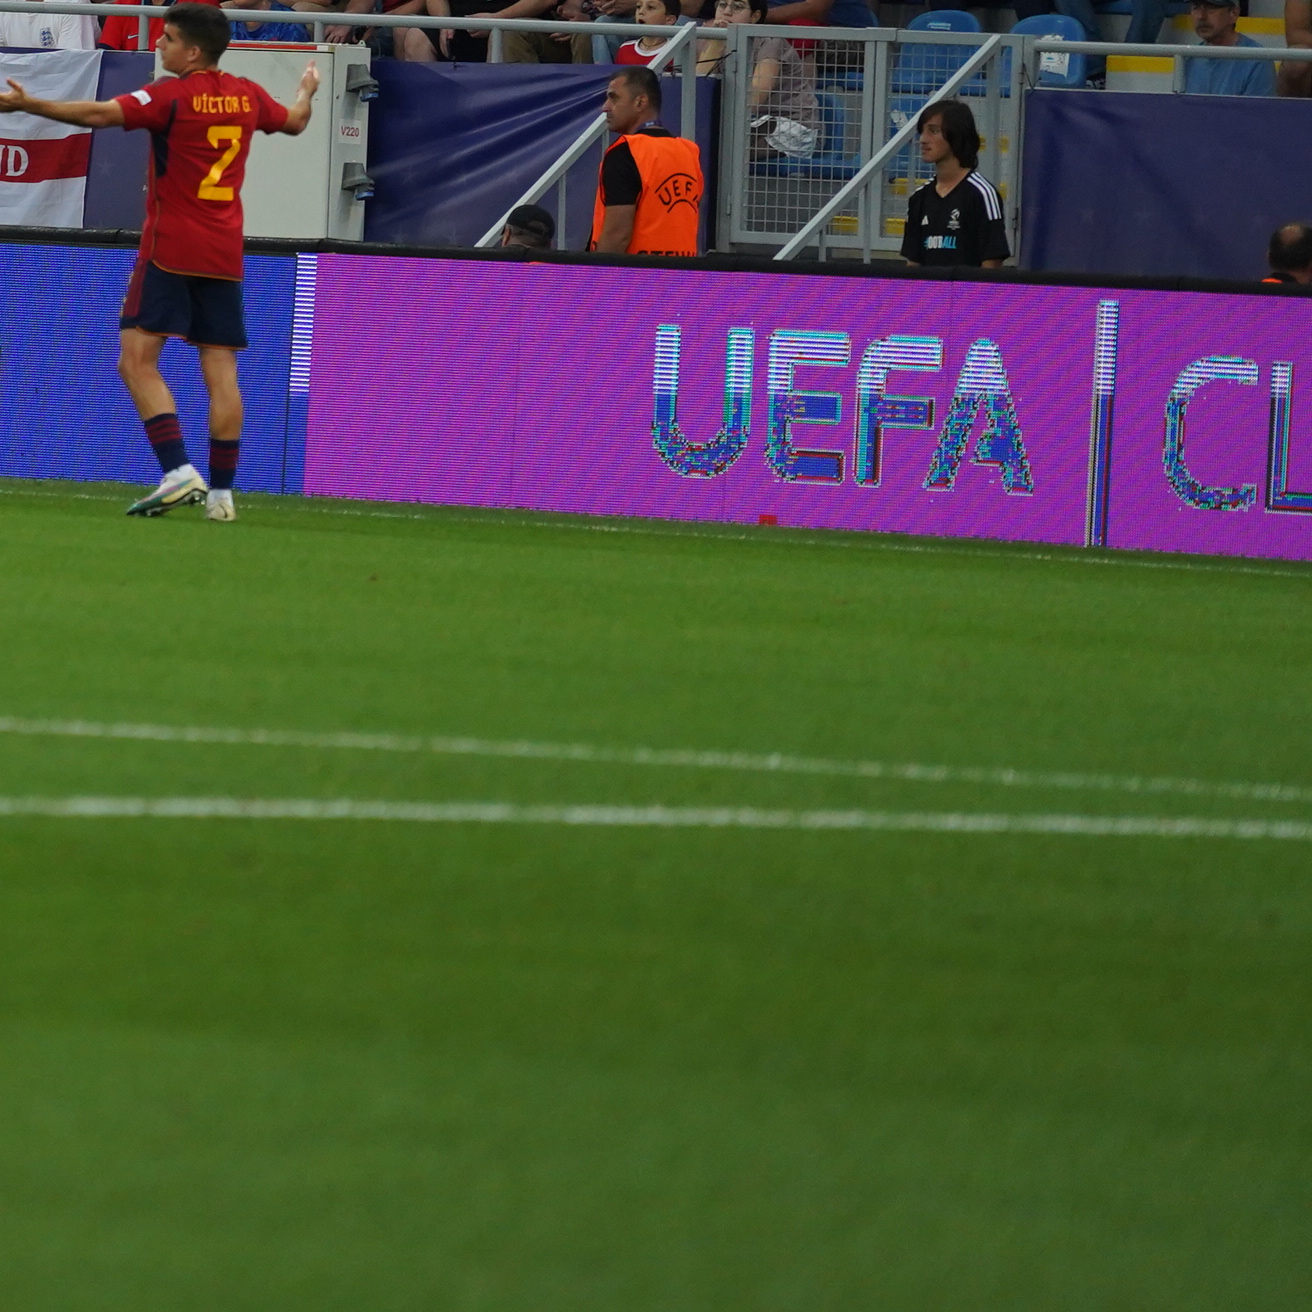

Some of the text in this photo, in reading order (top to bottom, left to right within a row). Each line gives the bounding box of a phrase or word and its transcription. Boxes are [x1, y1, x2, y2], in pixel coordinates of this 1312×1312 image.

[193, 93, 240, 115] VÍCTOR
[340, 124, 360, 138] V220
[197, 125, 243, 202] 2
[650, 323, 1034, 497] UEFA
